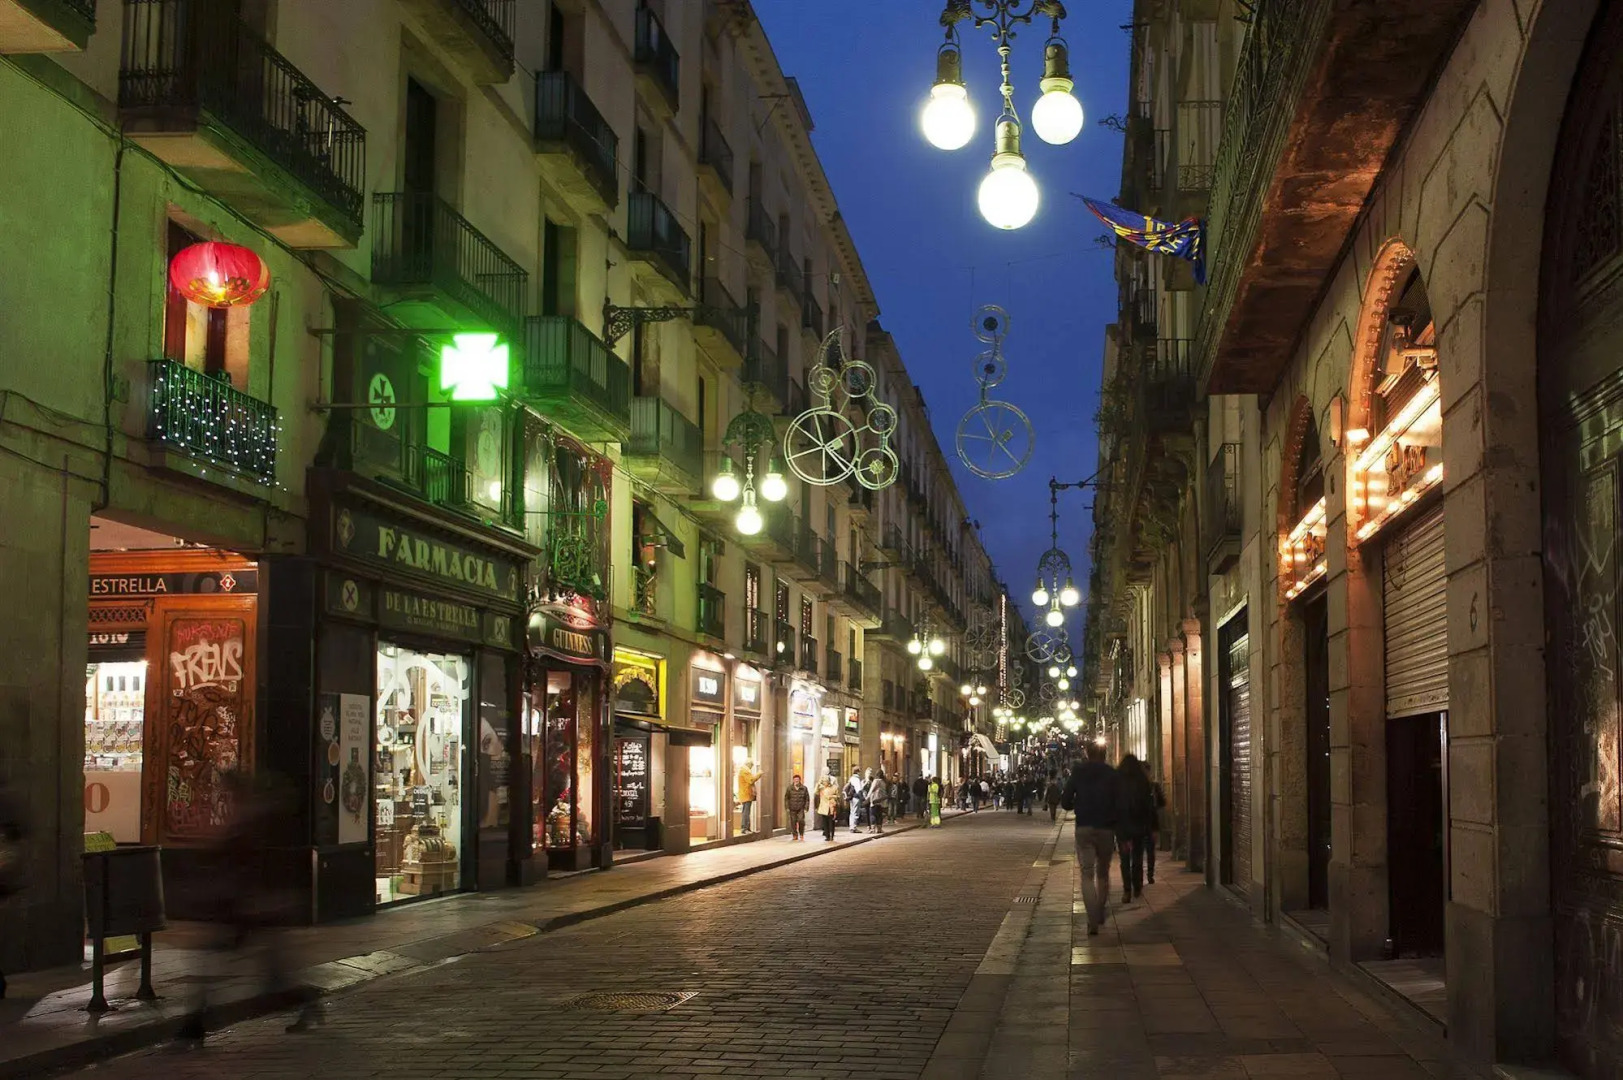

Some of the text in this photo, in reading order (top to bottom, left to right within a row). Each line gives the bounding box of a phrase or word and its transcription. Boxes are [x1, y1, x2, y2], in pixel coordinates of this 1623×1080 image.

[377, 525, 499, 591] FARMACIA
[92, 578, 167, 594] ESTRELLA
[385, 591, 401, 612] DE
[404, 595, 420, 615] LA
[421, 598, 478, 628] ESTRELLA
[553, 628, 593, 655] GUINNESS
